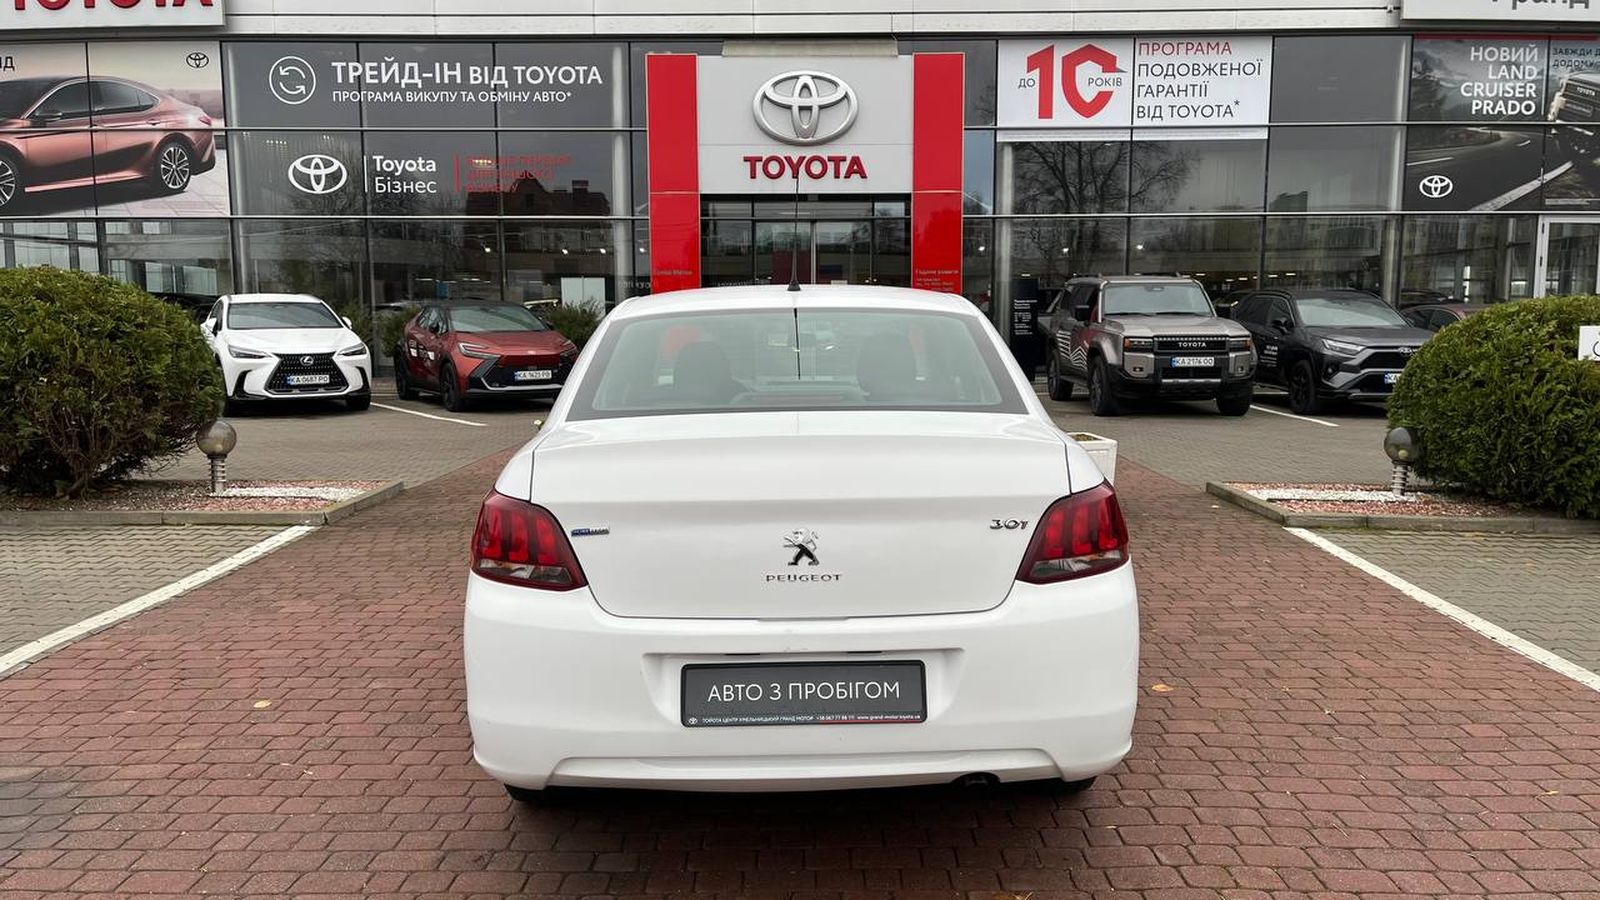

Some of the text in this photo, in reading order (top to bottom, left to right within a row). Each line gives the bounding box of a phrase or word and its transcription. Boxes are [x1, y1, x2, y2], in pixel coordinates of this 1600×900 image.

[1138, 41, 1232, 56] ПРОГРАМА
[1470, 44, 1539, 62] НОВИЙ
[332, 57, 603, 88] ТРЕЙД-ІН ВІД TOYOTA
[1138, 58, 1264, 79] ПОДОВЖЕНОЇ
[1488, 65, 1537, 80] LAND
[1018, 77, 1123, 89] ДО РОКІВ
[1136, 80, 1209, 98] ГАРАНТІЇ
[1460, 82, 1537, 97] CRUISER
[332, 91, 403, 103] ПРОГРАМА
[406, 91, 457, 102] ВИКУПУ
[460, 91, 475, 102] ТА
[478, 91, 530, 102] ОБМІНУ
[1136, 105, 1164, 122] ВІД
[1472, 100, 1536, 116] PRADO
[372, 155, 437, 178] Toyota
[743, 156, 868, 179] TOYOTA
[375, 175, 437, 194] Бізнес
[989, 519, 1030, 531] 301
[765, 573, 843, 583] PEUGEOT
[707, 683, 763, 702] АВТО
[788, 681, 900, 700] ПРОБІГОМ
